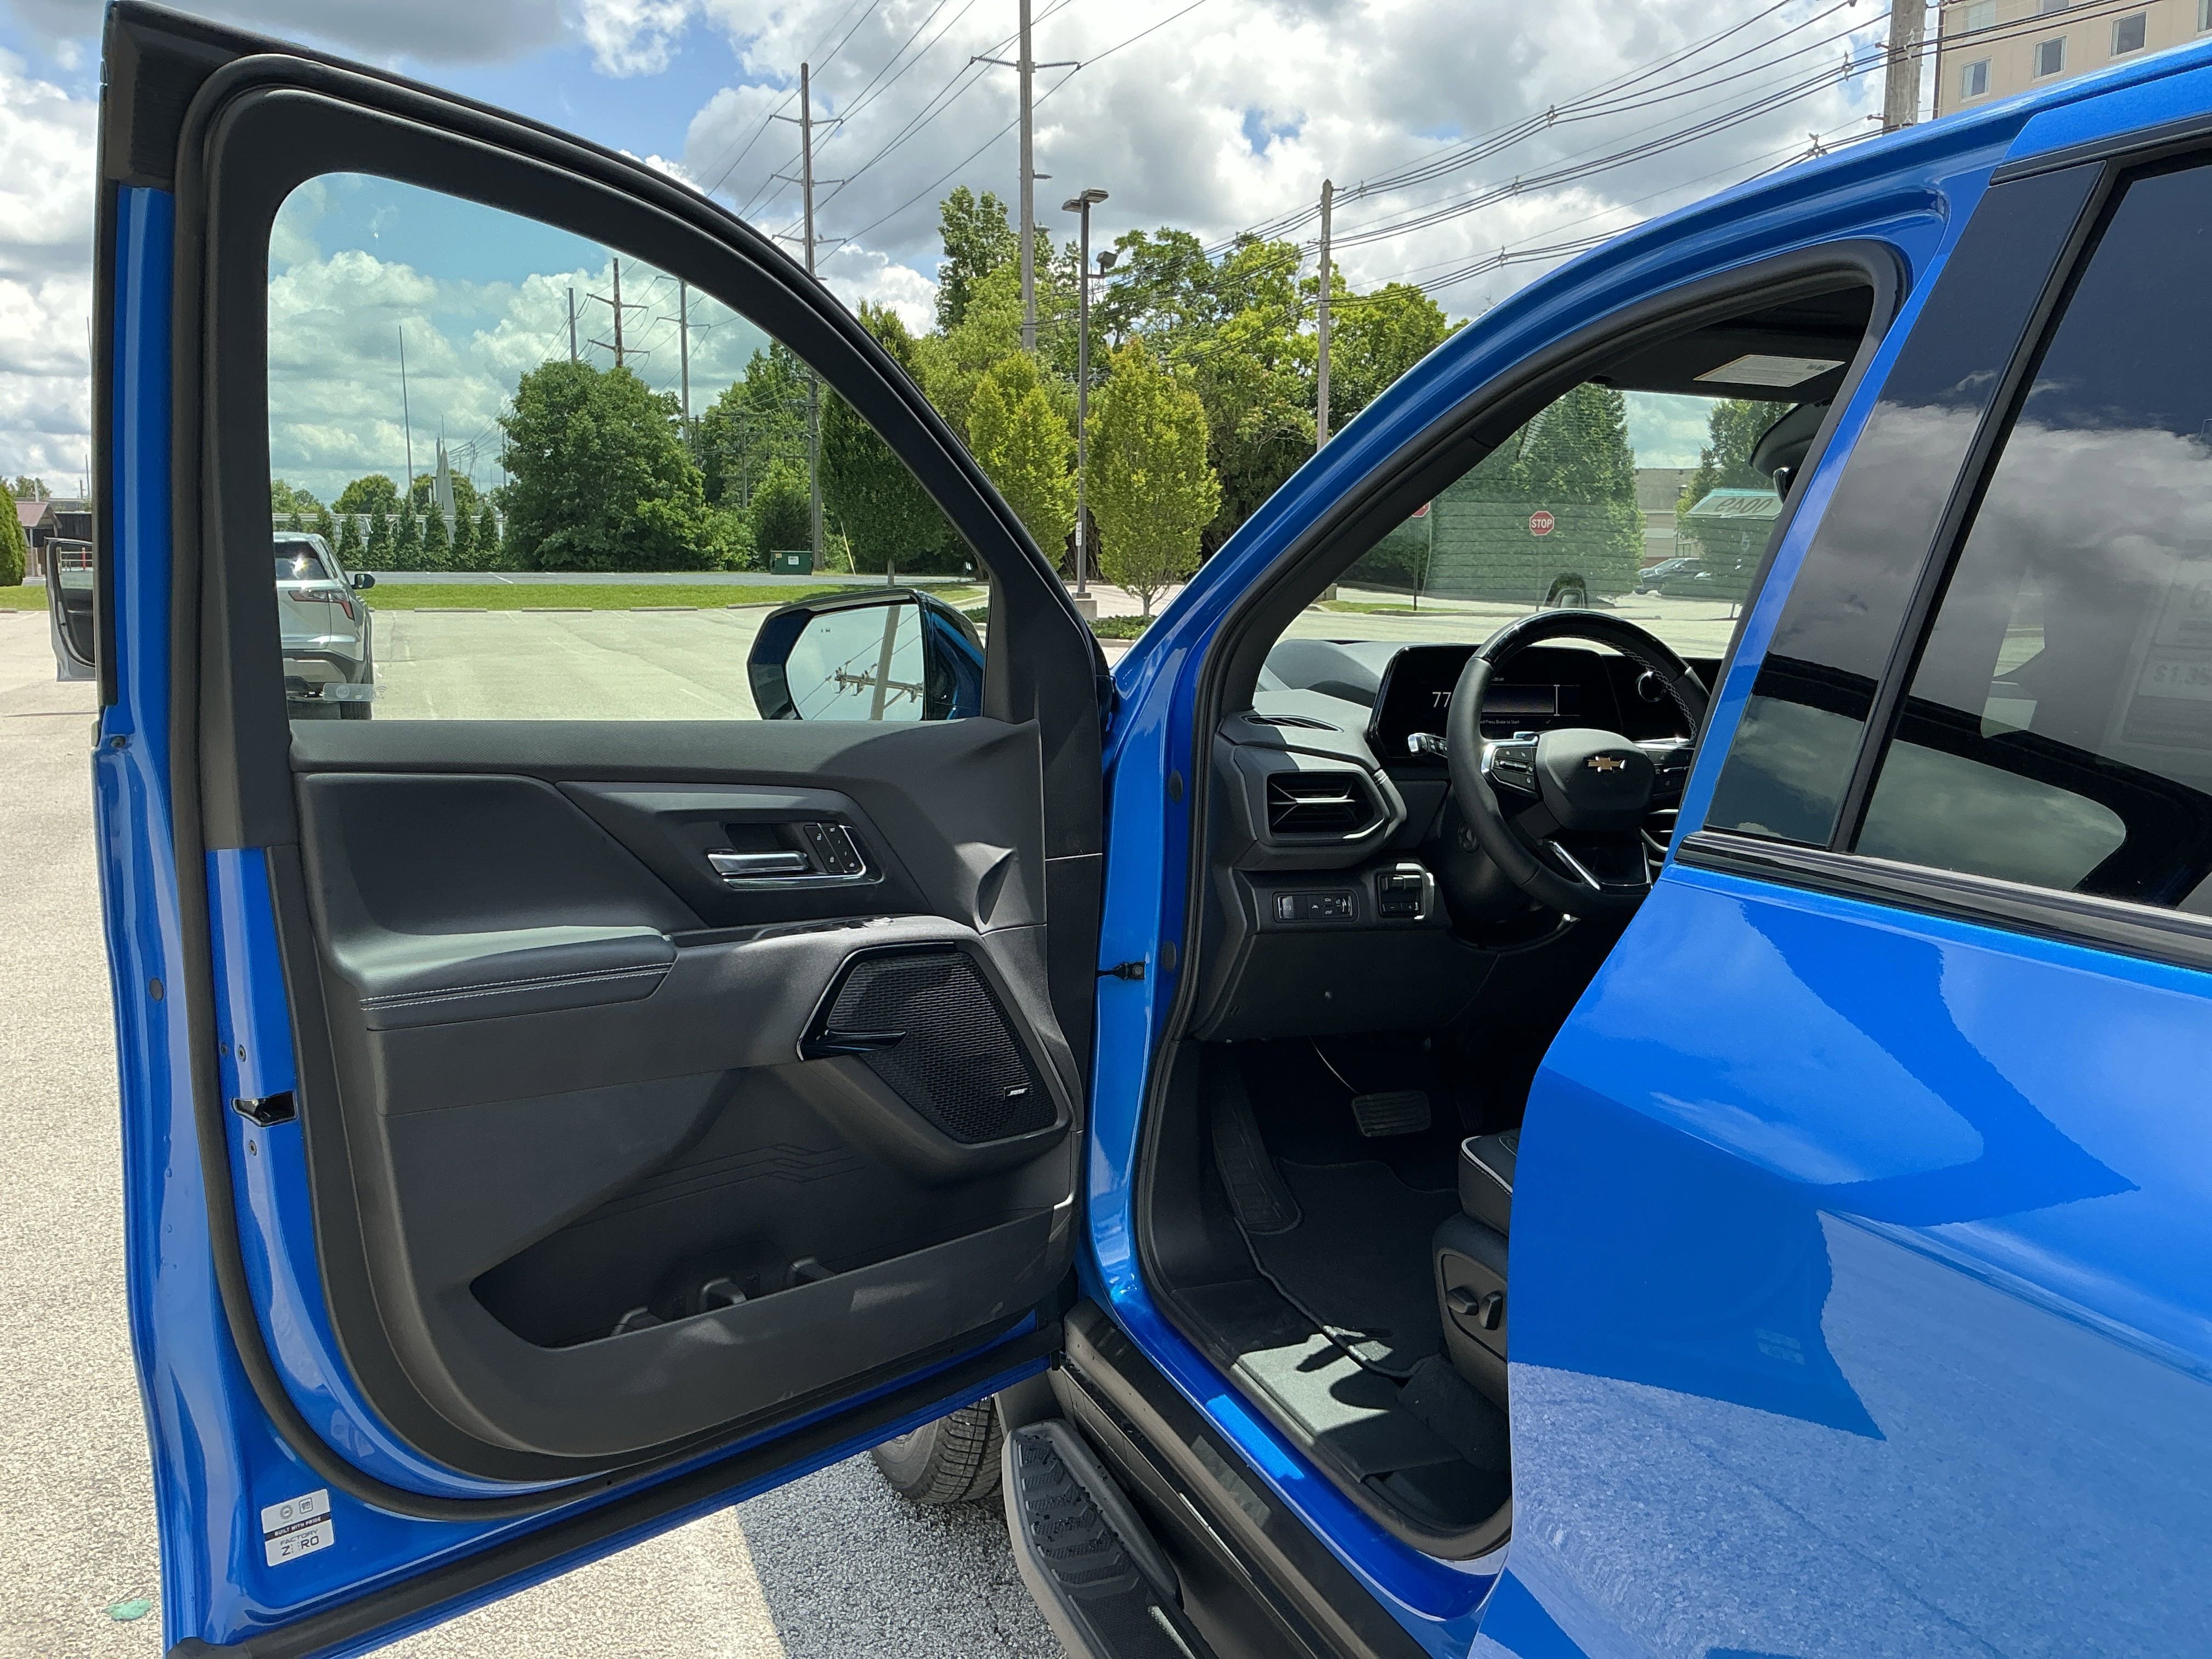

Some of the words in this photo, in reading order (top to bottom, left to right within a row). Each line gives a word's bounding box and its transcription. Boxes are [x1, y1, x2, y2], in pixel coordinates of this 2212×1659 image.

[1532, 519, 1552, 528] STOP
[2153, 664, 2212, 686] $1,35
[1432, 691, 1452, 708] 77
[275, 1527, 290, 1536] BUILT
[305, 1516, 322, 1526] PRIDE
[280, 1529, 318, 1546] FACTORY
